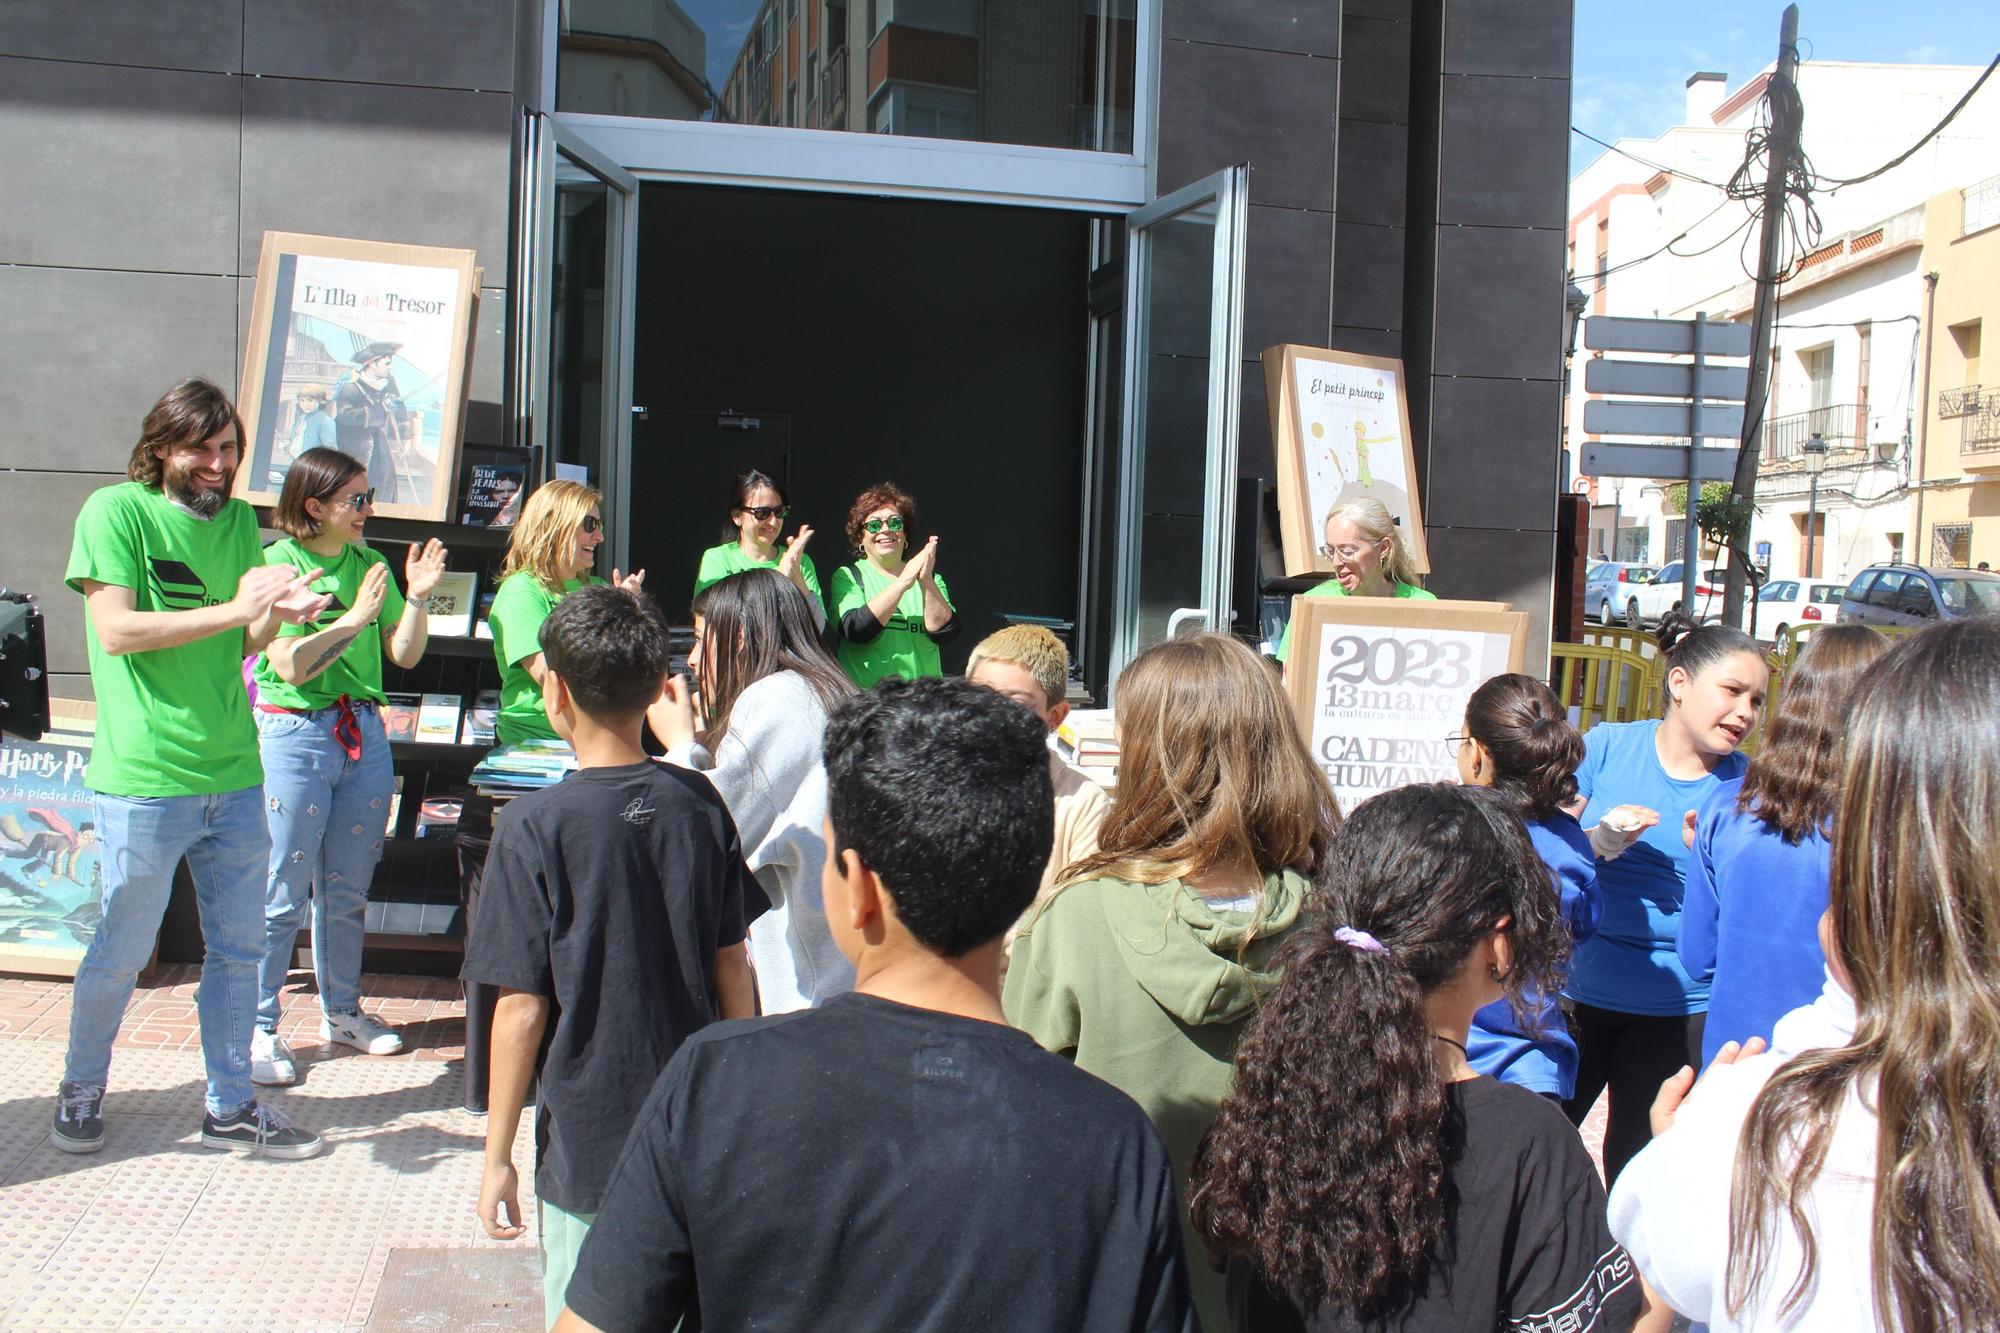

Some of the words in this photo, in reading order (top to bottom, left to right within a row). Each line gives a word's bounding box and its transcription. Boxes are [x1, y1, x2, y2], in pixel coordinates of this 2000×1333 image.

[386, 293, 445, 315] Tresor
[1310, 378, 1322, 394] El
[1324, 382, 1346, 396] petit
[474, 469, 497, 478] BLUE
[472, 478, 500, 489] JEANS
[1327, 634, 1472, 689] 2023
[1325, 707, 1335, 717] la
[1339, 708, 1384, 720] cultura
[0, 748, 63, 779] Harry
[0, 787, 9, 798] y
[13, 783, 24, 798] la
[28, 787, 67, 802] piedra
